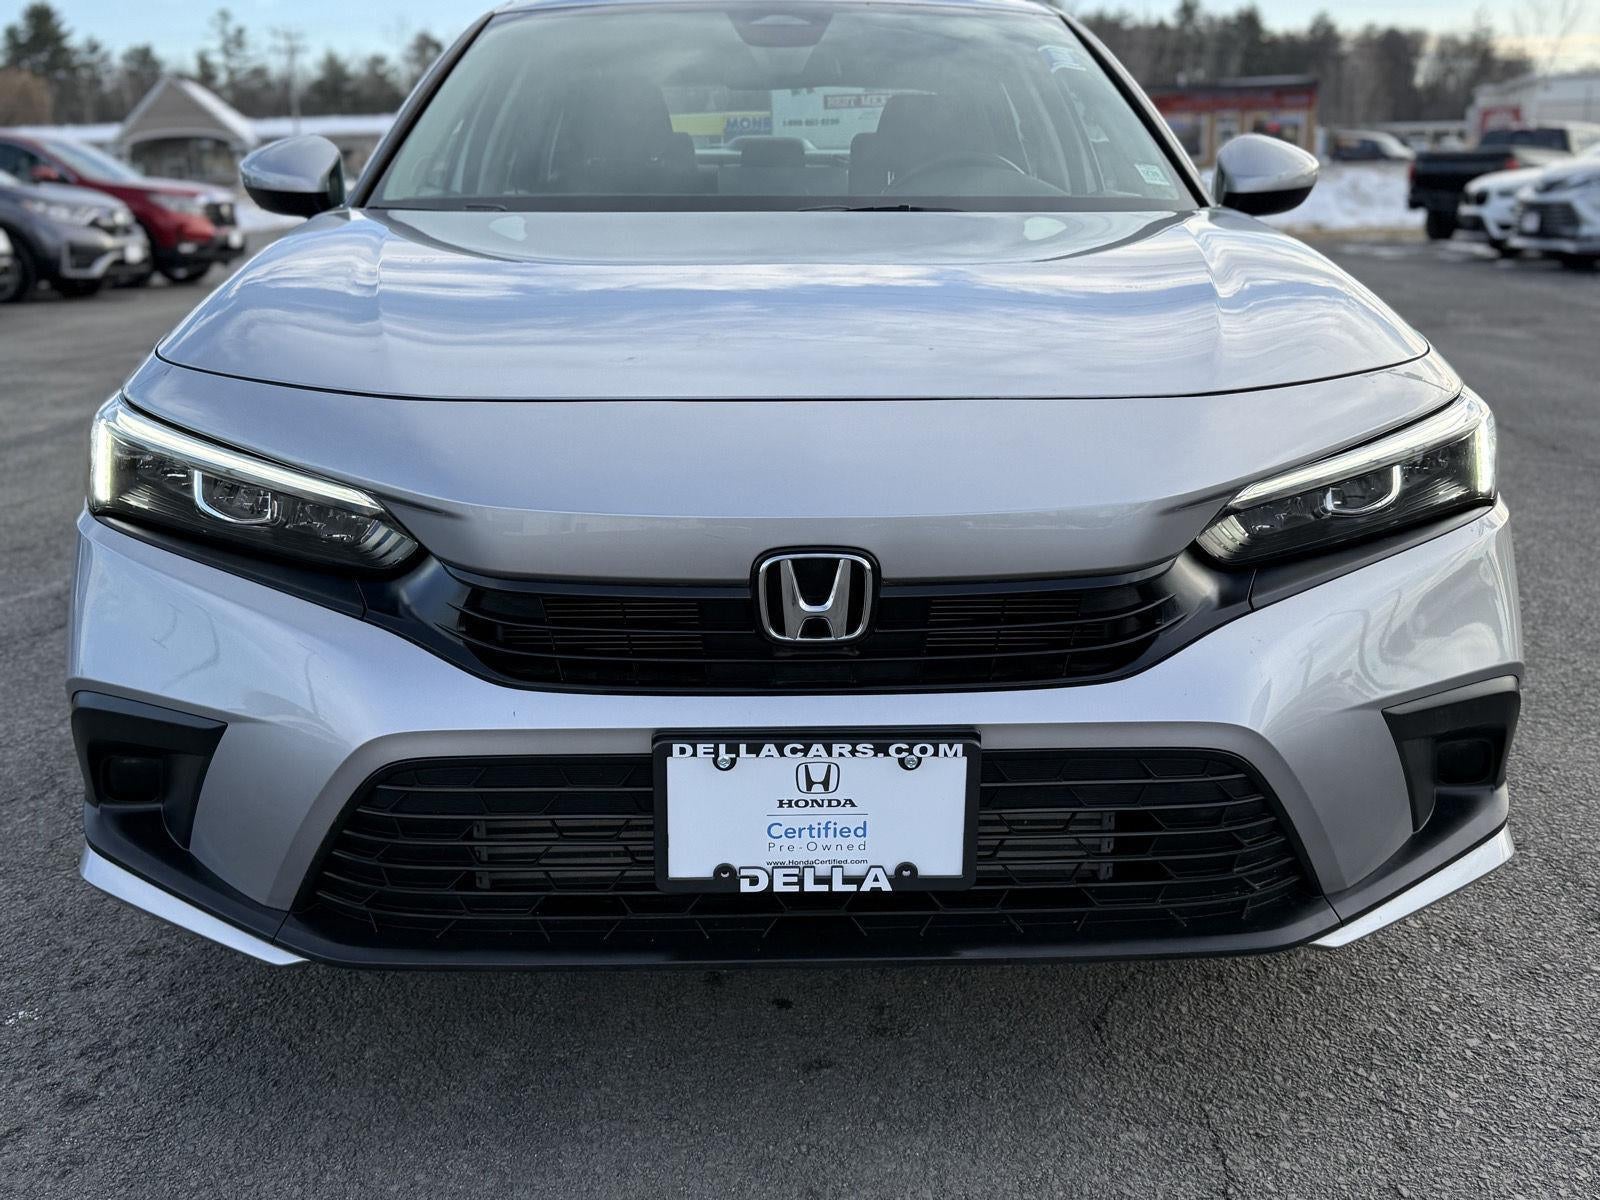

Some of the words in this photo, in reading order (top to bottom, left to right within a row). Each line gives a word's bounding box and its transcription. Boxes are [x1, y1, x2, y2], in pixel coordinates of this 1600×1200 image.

[671, 743, 964, 758] DELLACARS.COM
[776, 798, 859, 809] HONDA
[766, 820, 868, 840] Certified
[767, 840, 867, 853] Pre-Owned
[766, 858, 869, 867] www.HondaCertified.com
[739, 866, 894, 894] DELLA
